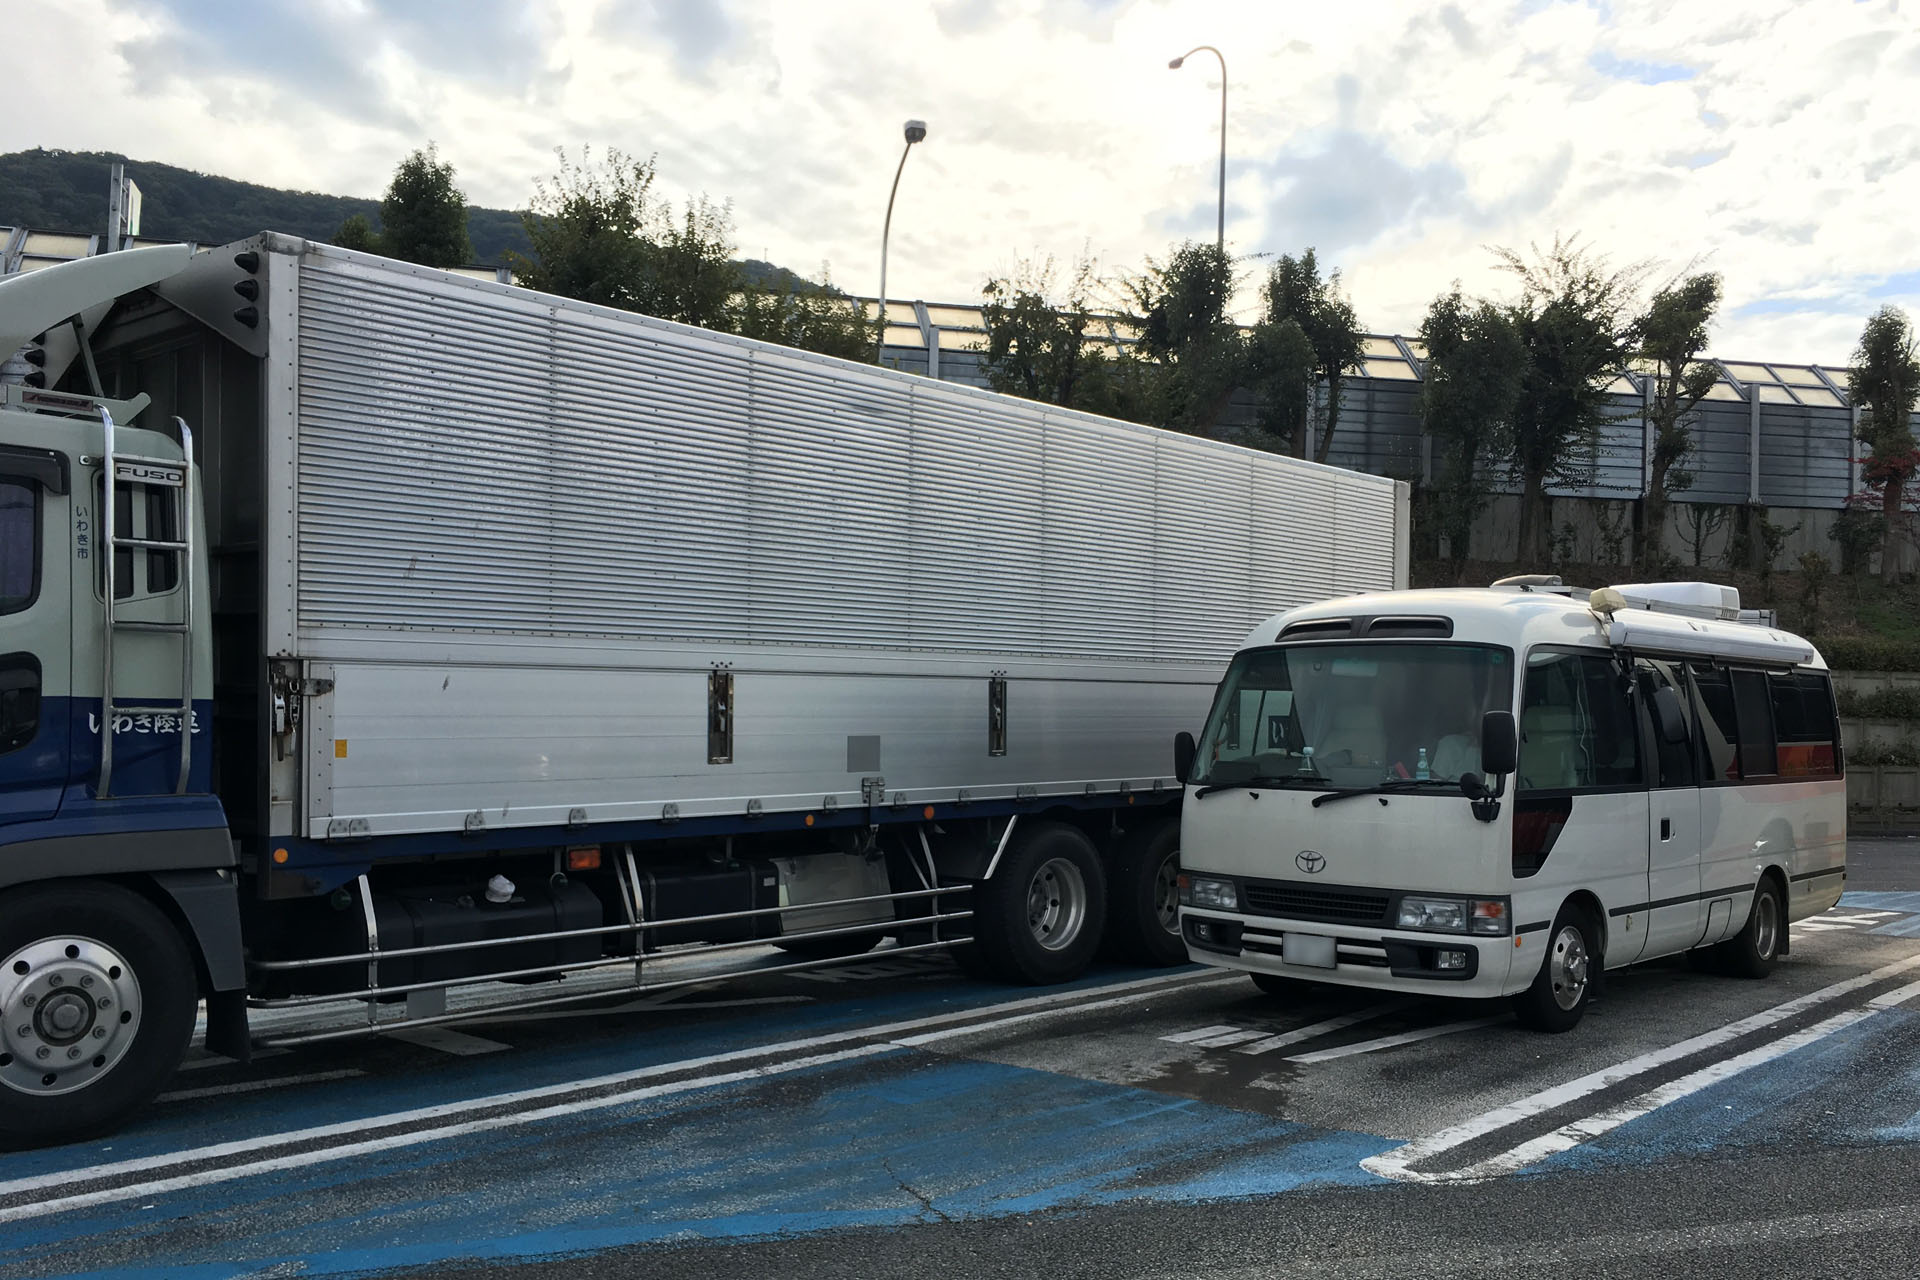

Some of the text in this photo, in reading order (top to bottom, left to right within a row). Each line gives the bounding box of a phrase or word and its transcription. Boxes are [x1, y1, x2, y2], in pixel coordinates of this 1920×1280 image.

[116, 466, 183, 482] FUSO
[76, 505, 89, 560] いわき市
